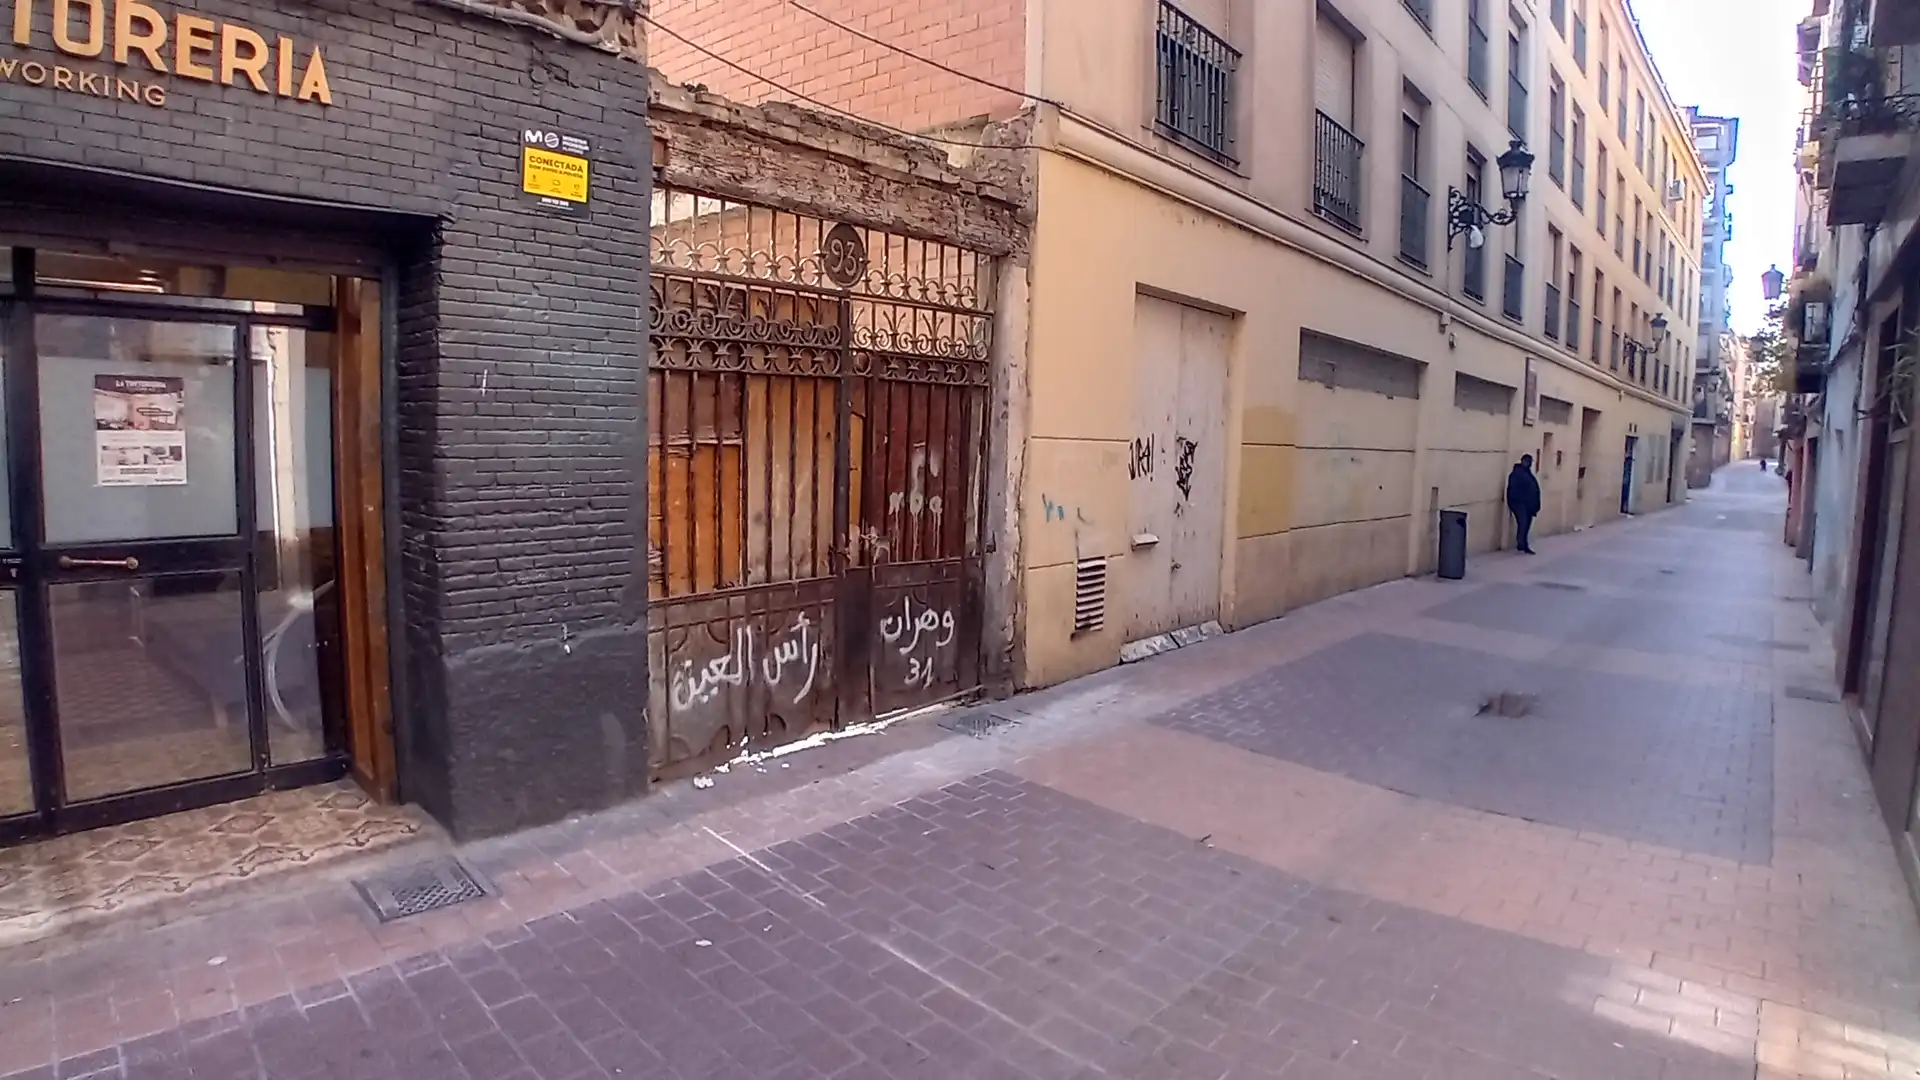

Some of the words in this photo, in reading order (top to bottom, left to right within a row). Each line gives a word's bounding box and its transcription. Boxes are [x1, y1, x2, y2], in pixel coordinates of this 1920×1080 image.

[529, 155, 584, 173] CONECTADA
[831, 239, 857, 276] 93
[904, 657, 933, 690] 31
